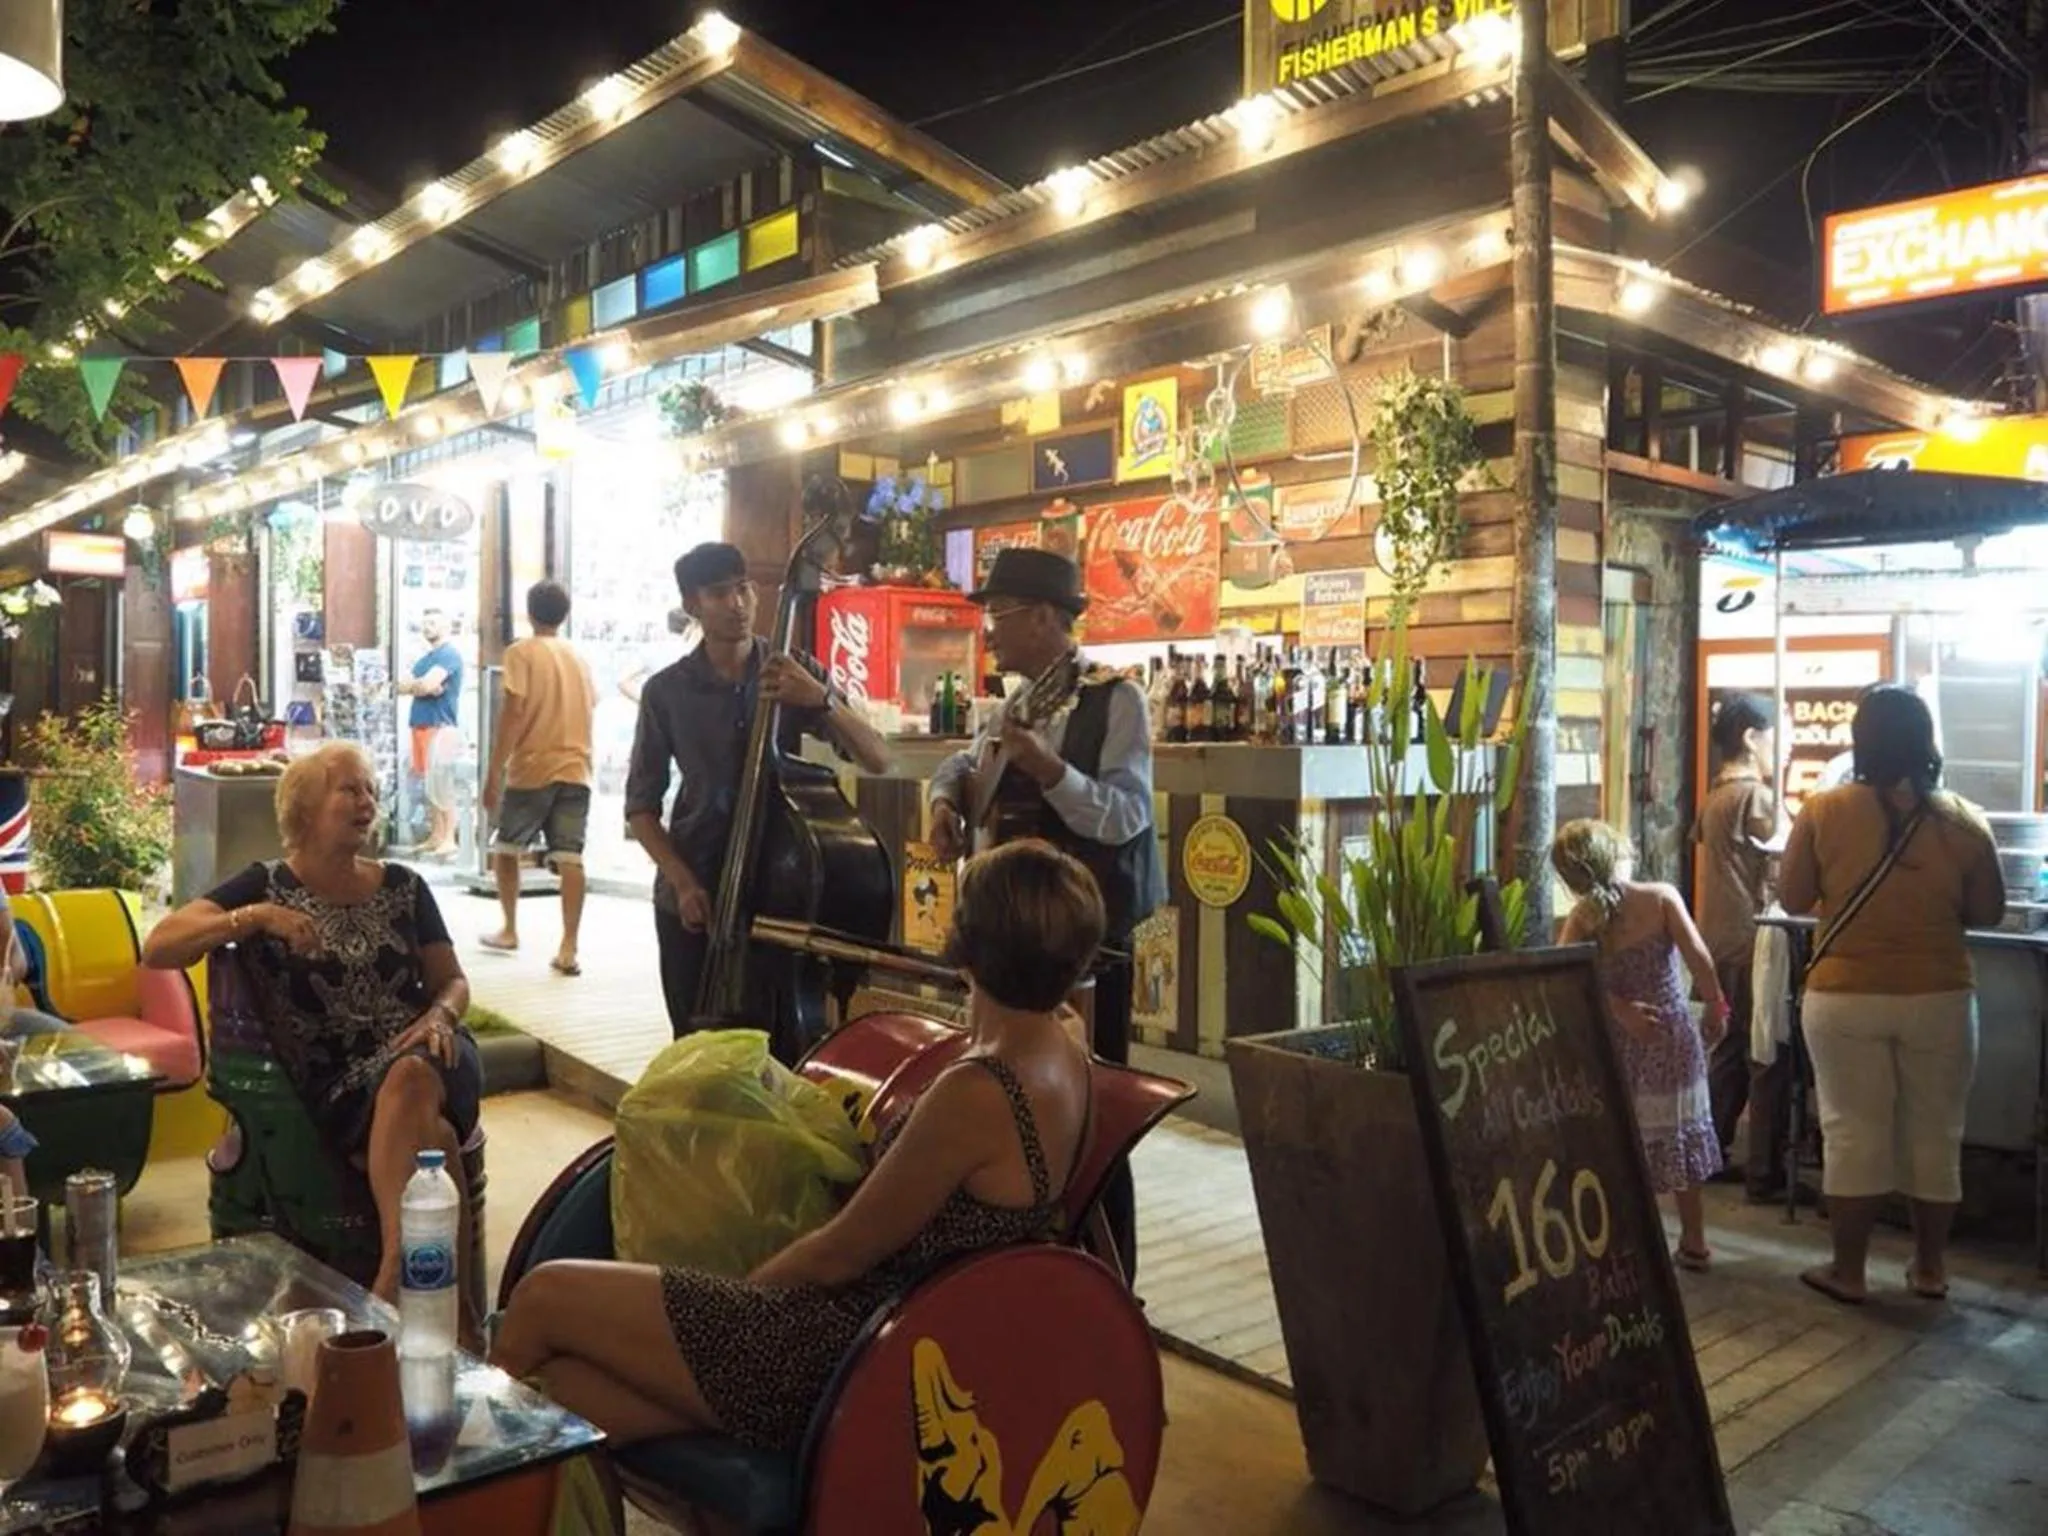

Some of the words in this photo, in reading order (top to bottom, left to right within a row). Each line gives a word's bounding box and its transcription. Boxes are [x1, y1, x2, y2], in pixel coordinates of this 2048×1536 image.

[1278, 5, 1438, 85] FISHERMANS
[1433, 988, 1557, 1119] Special
[1486, 1158, 1610, 1306] 160
